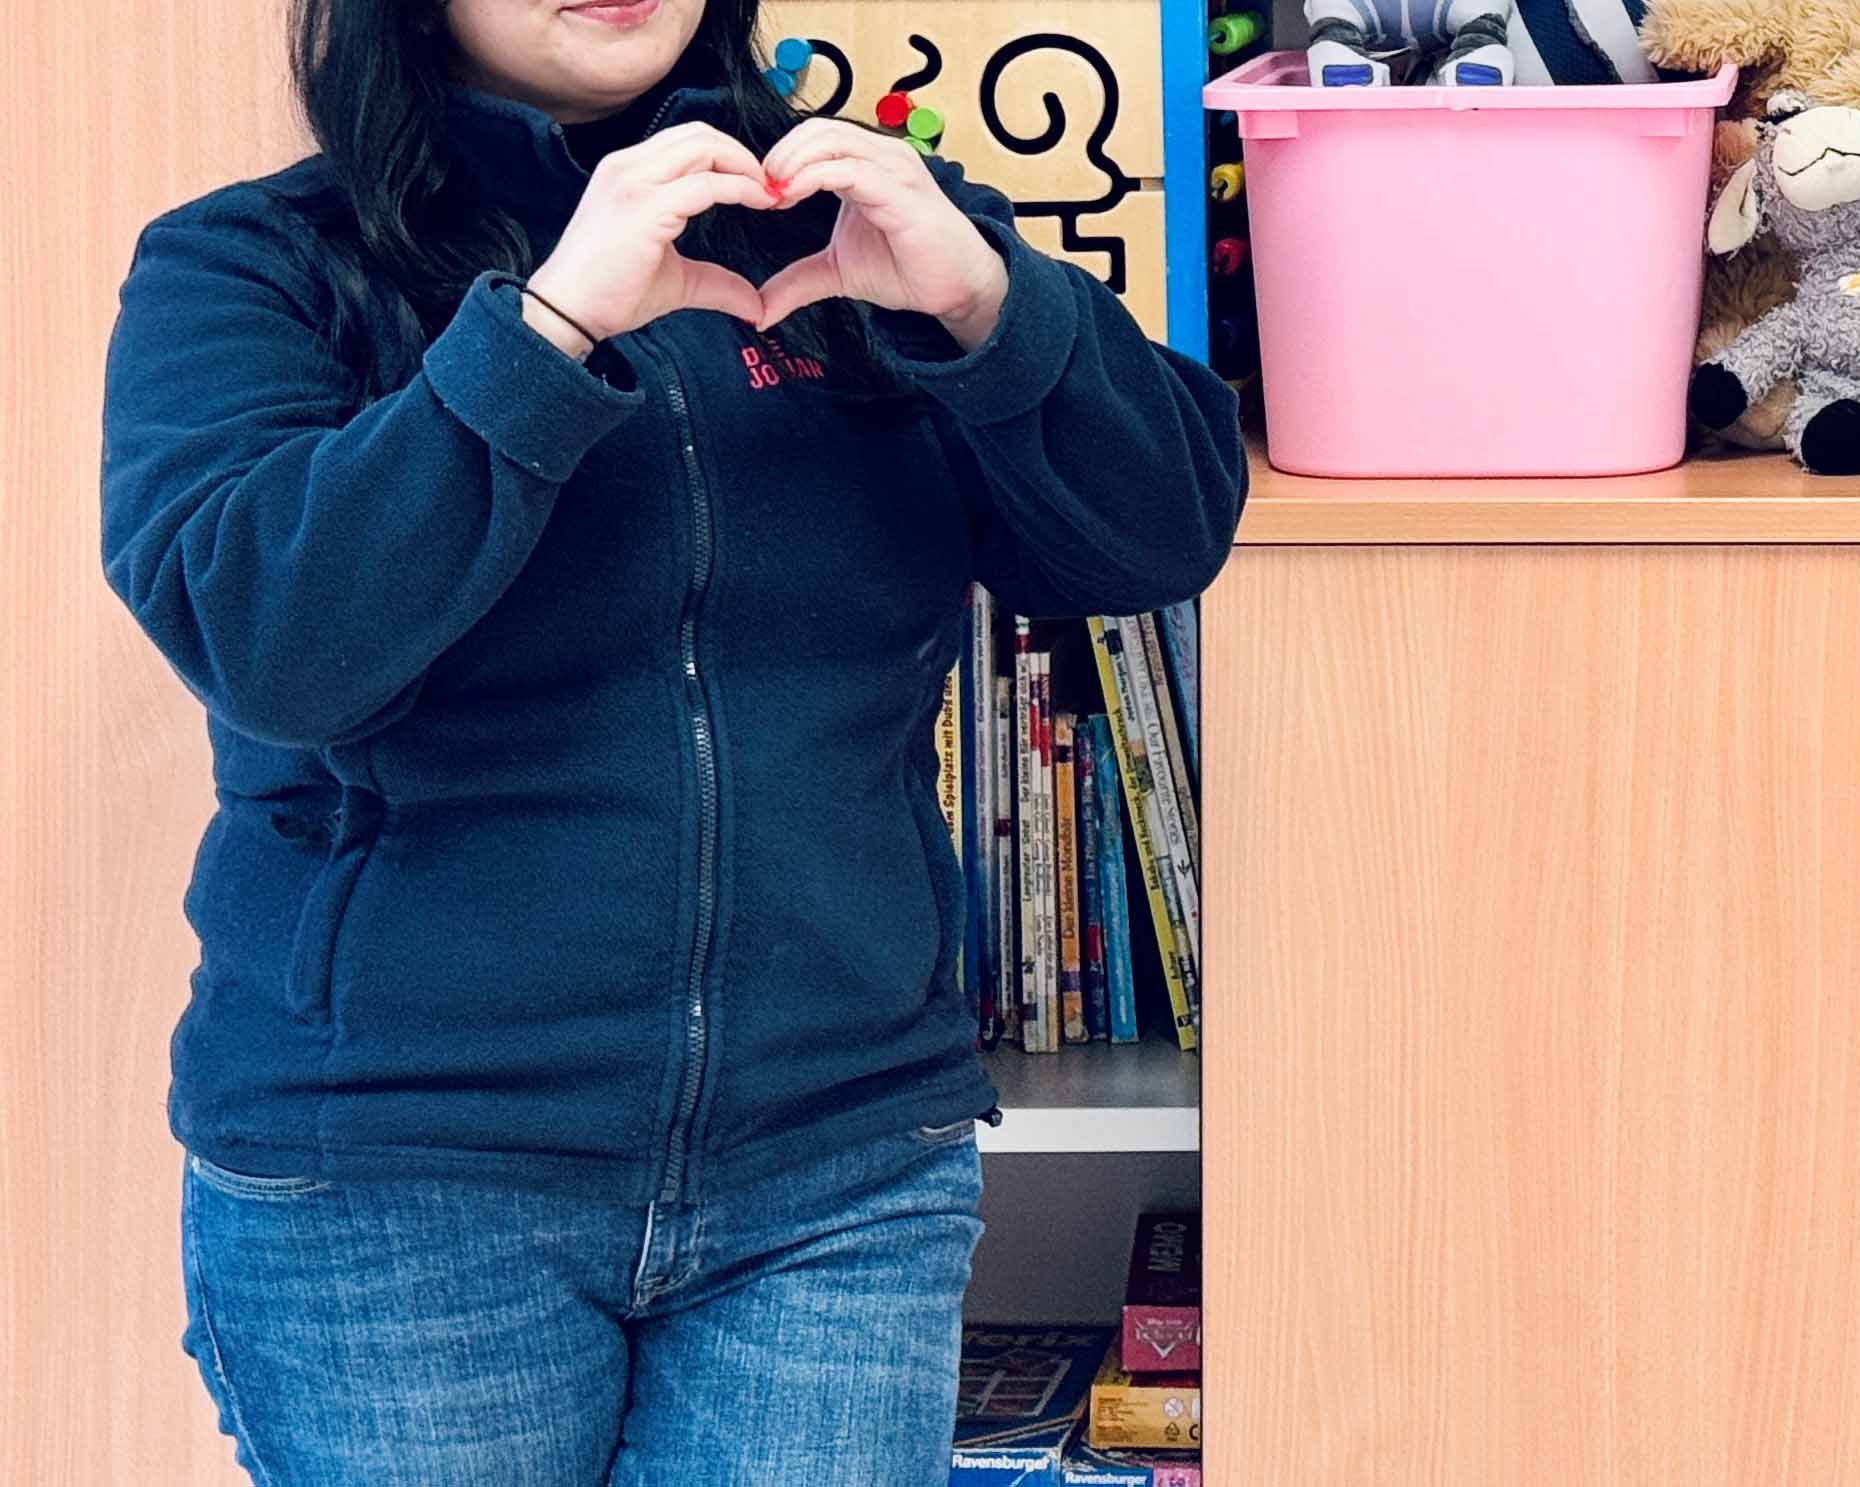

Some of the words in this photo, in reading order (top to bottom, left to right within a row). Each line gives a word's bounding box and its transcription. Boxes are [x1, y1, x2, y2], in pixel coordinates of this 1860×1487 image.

[1018, 697, 1030, 735] verträgt
[1019, 756, 1030, 784] kleine
[1061, 815, 1074, 873] Mondbär
[1061, 876, 1074, 913] kleine
[1062, 916, 1075, 939] Der
[951, 1454, 1051, 1472] Ravensburger
[1064, 1471, 1148, 1486] Ravensburger
